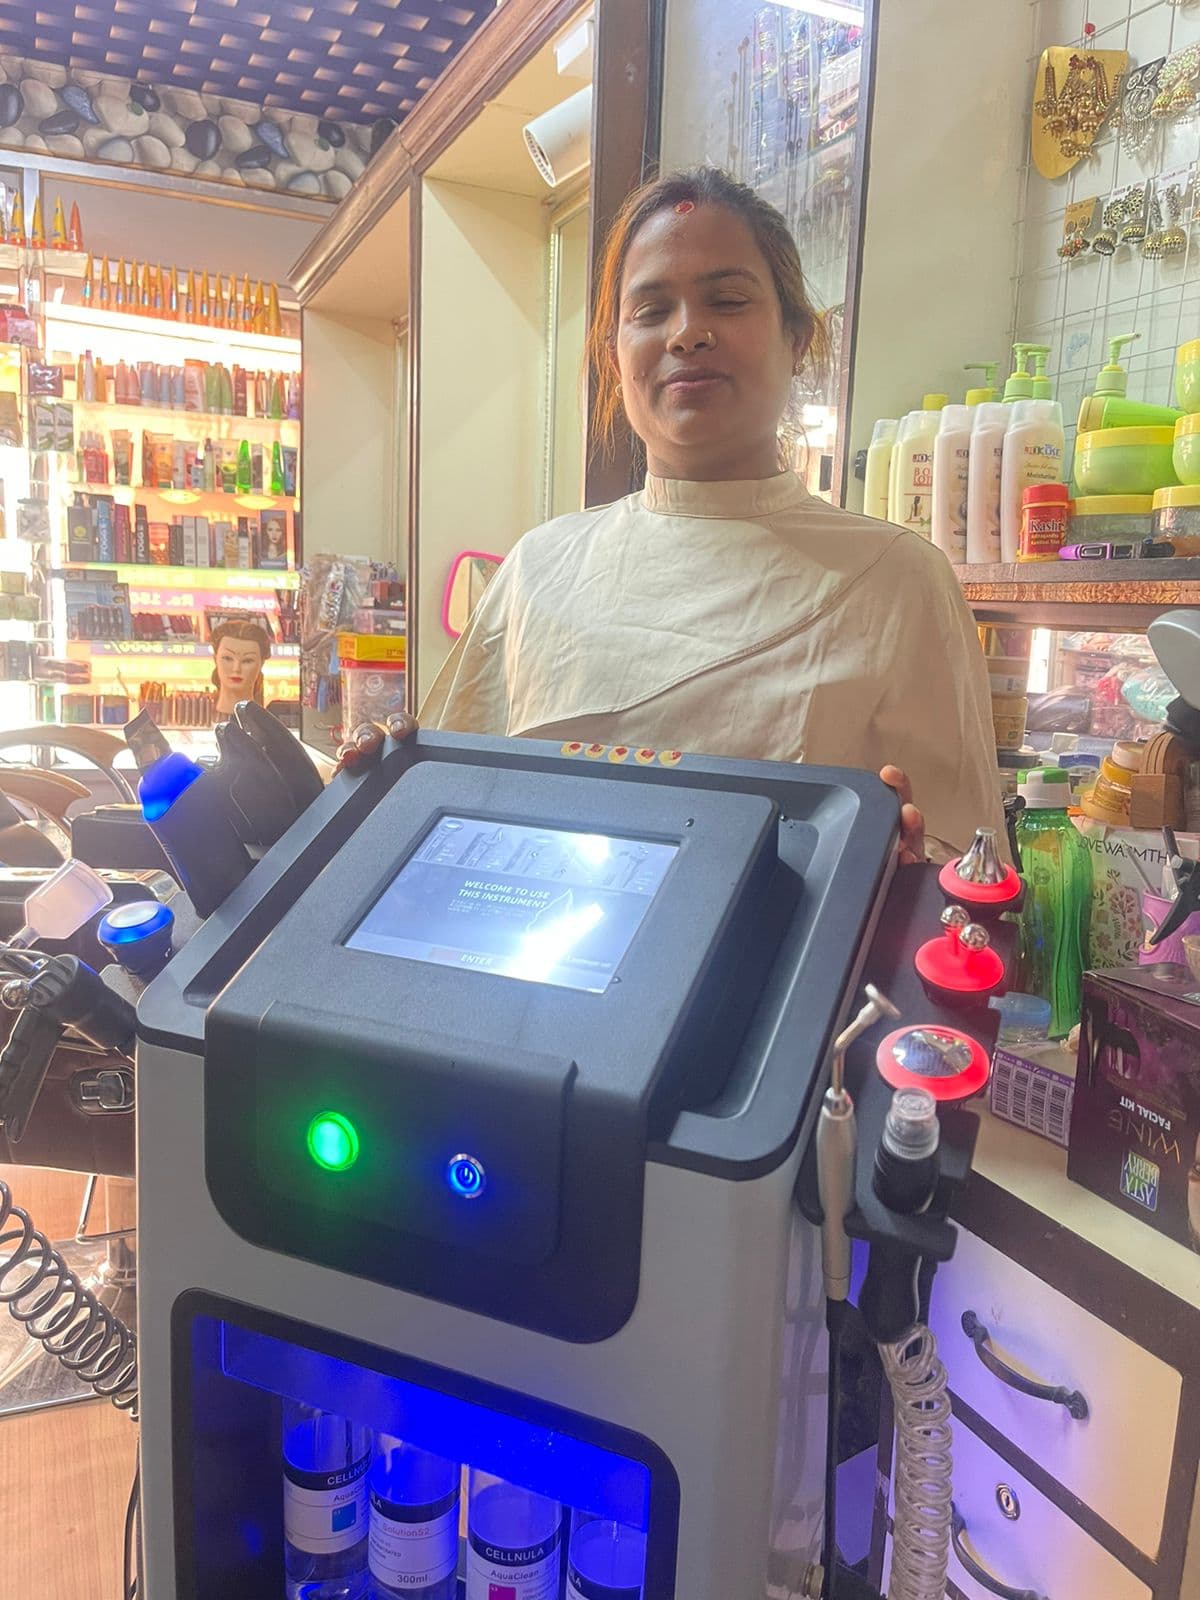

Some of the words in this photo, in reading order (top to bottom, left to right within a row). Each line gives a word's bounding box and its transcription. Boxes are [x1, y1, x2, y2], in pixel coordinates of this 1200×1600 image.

[458, 889, 481, 899] THIS
[481, 892, 546, 908] INSTRUMENT
[464, 880, 513, 893] WELCOME
[515, 888, 528, 896] TO
[530, 890, 550, 899] USE
[460, 953, 493, 965] ENTER
[1119, 1095, 1136, 1112] KIT
[1136, 1103, 1172, 1131] FACIAL
[1108, 1109, 1181, 1164] WINE
[1124, 1154, 1158, 1188] BERRY
[485, 1547, 545, 1561] CELLNULA
[397, 1574, 428, 1584] 300ml
[490, 1569, 540, 1580] AquaClean
